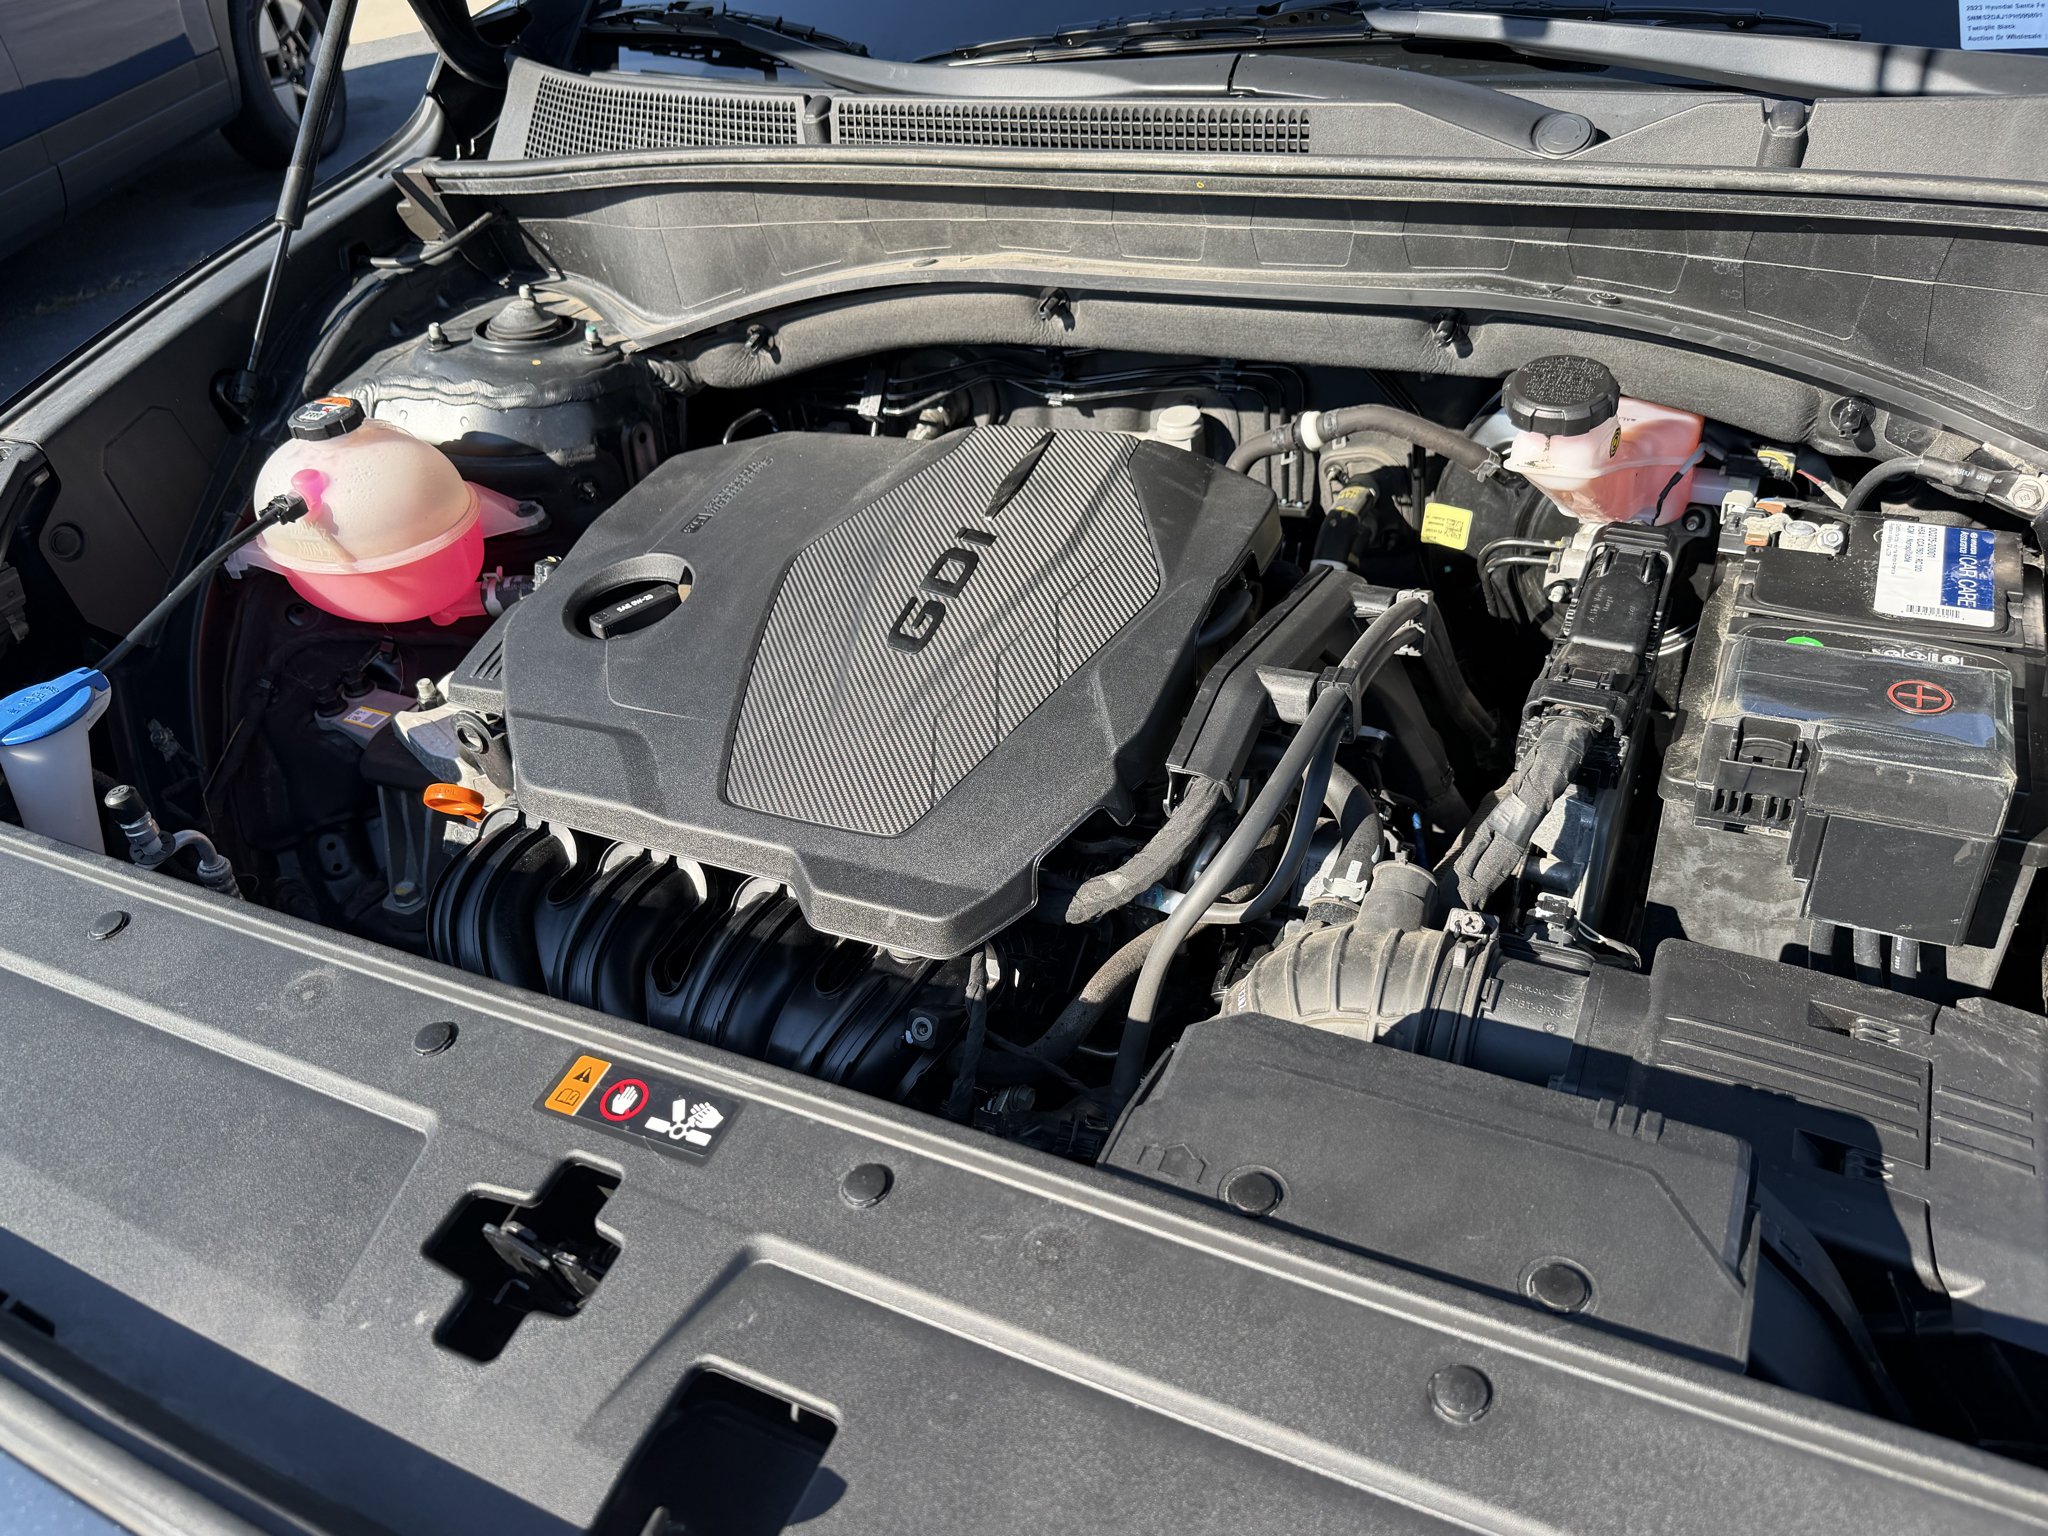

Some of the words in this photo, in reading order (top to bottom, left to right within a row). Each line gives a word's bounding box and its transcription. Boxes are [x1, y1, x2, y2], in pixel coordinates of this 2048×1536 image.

[1960, 530, 1969, 554] Assurance
[1958, 557, 1978, 578] CAR
[1957, 579, 1978, 608] CARE
